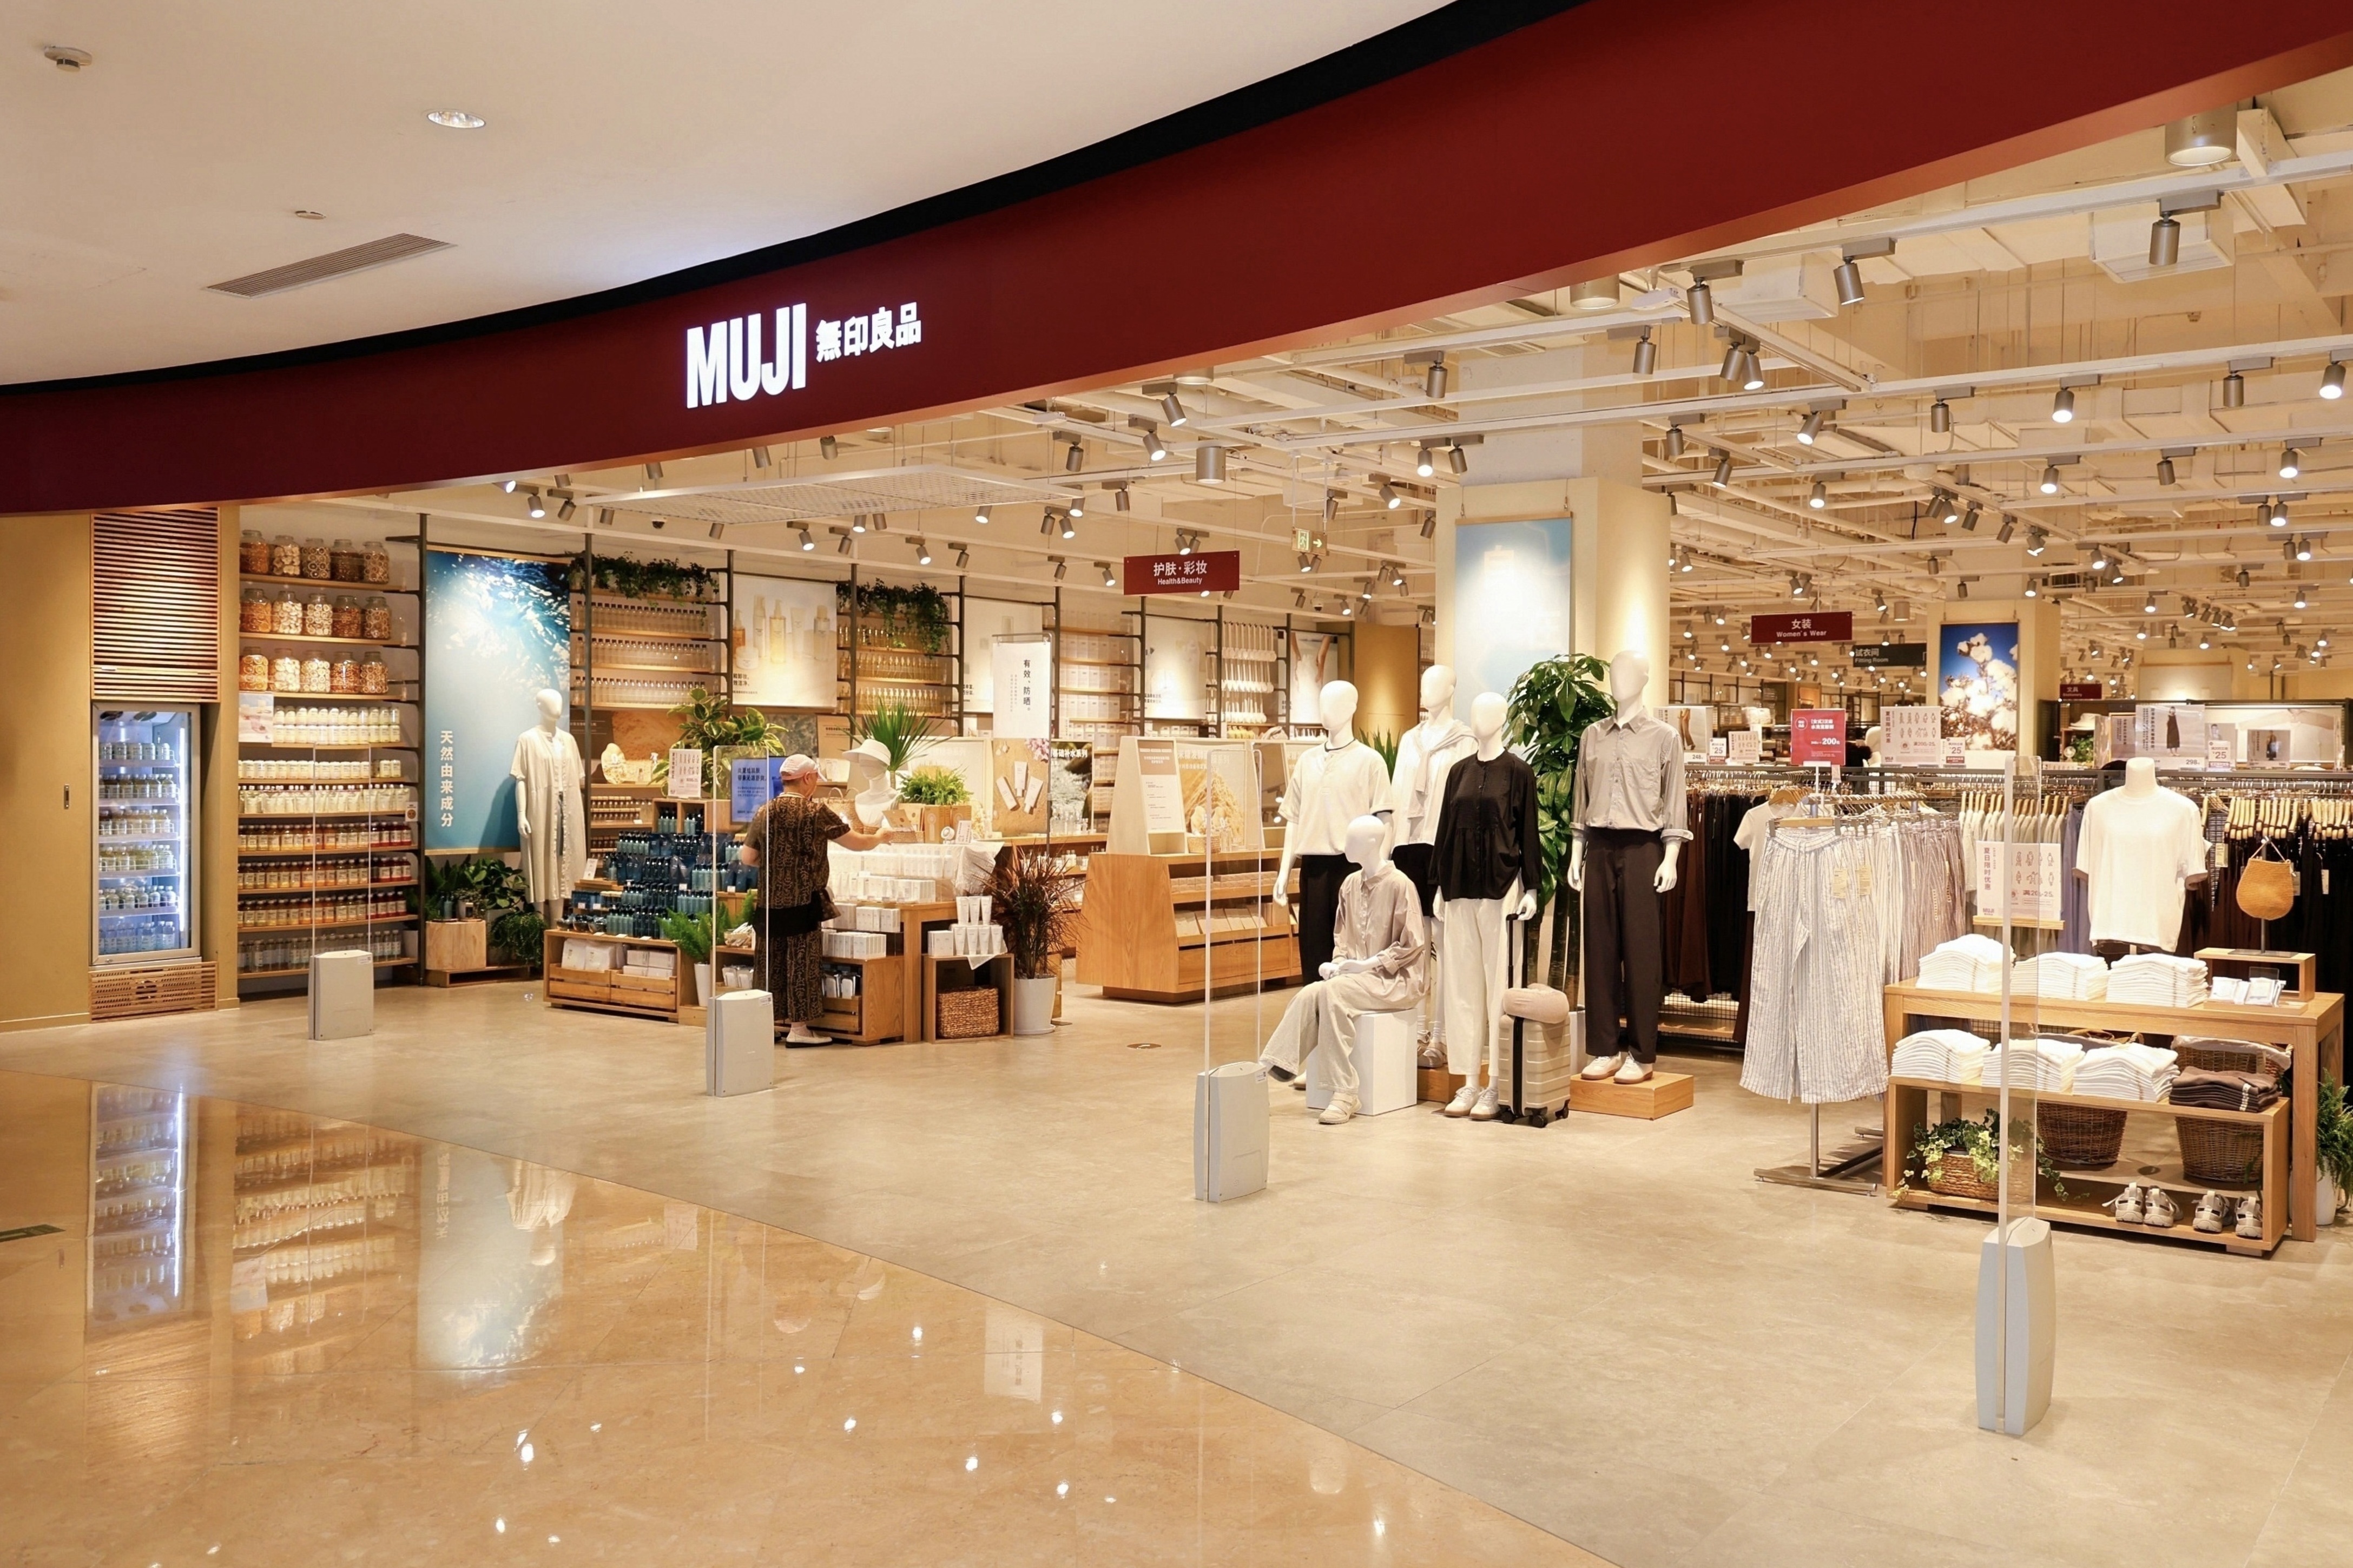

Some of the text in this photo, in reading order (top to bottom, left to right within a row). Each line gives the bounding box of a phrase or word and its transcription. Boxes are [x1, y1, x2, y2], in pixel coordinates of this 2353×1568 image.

[816, 301, 922, 363] 無印良品
[687, 302, 807, 409] MUJI
[1154, 559, 1208, 576] 护肤·彩妆
[1157, 577, 1202, 585] Health&Beauty
[1791, 618, 1811, 629] 女装
[1855, 648, 1880, 657] 试衣间
[440, 730, 453, 827] 天然由来成分
